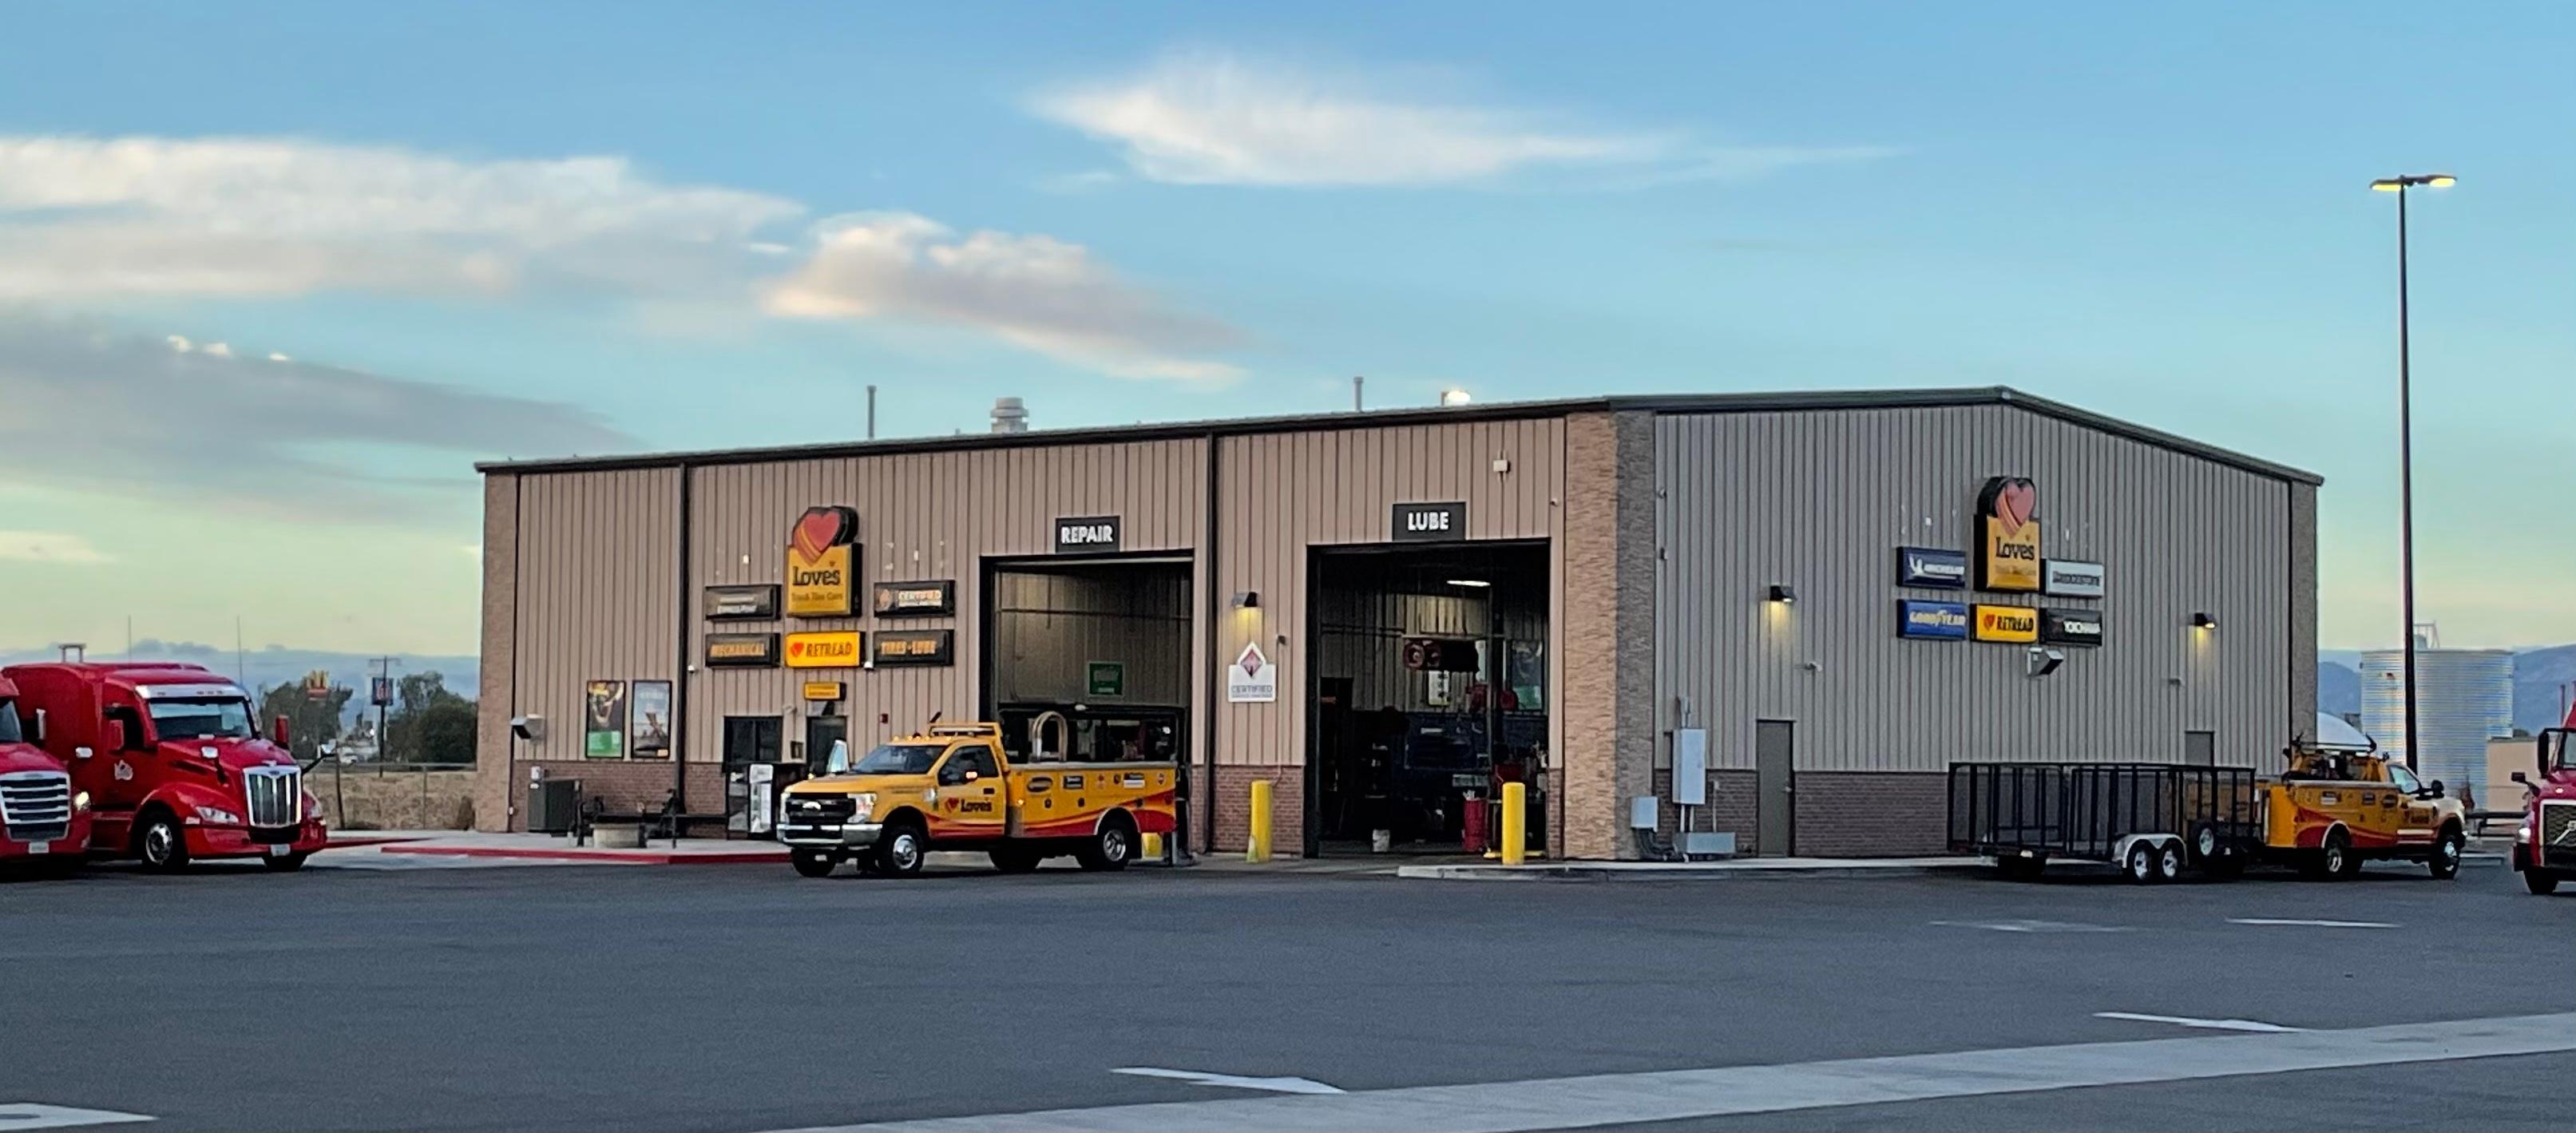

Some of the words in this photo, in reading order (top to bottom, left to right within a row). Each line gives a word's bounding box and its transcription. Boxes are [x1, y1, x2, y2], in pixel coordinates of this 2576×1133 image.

[1407, 511, 1449, 531] LUBE
[1060, 524, 1113, 545] REPAIR
[1997, 615, 2034, 632] RETREAD
[806, 642, 853, 657] RETREAD
[1231, 684, 1273, 693] CERTIFIED
